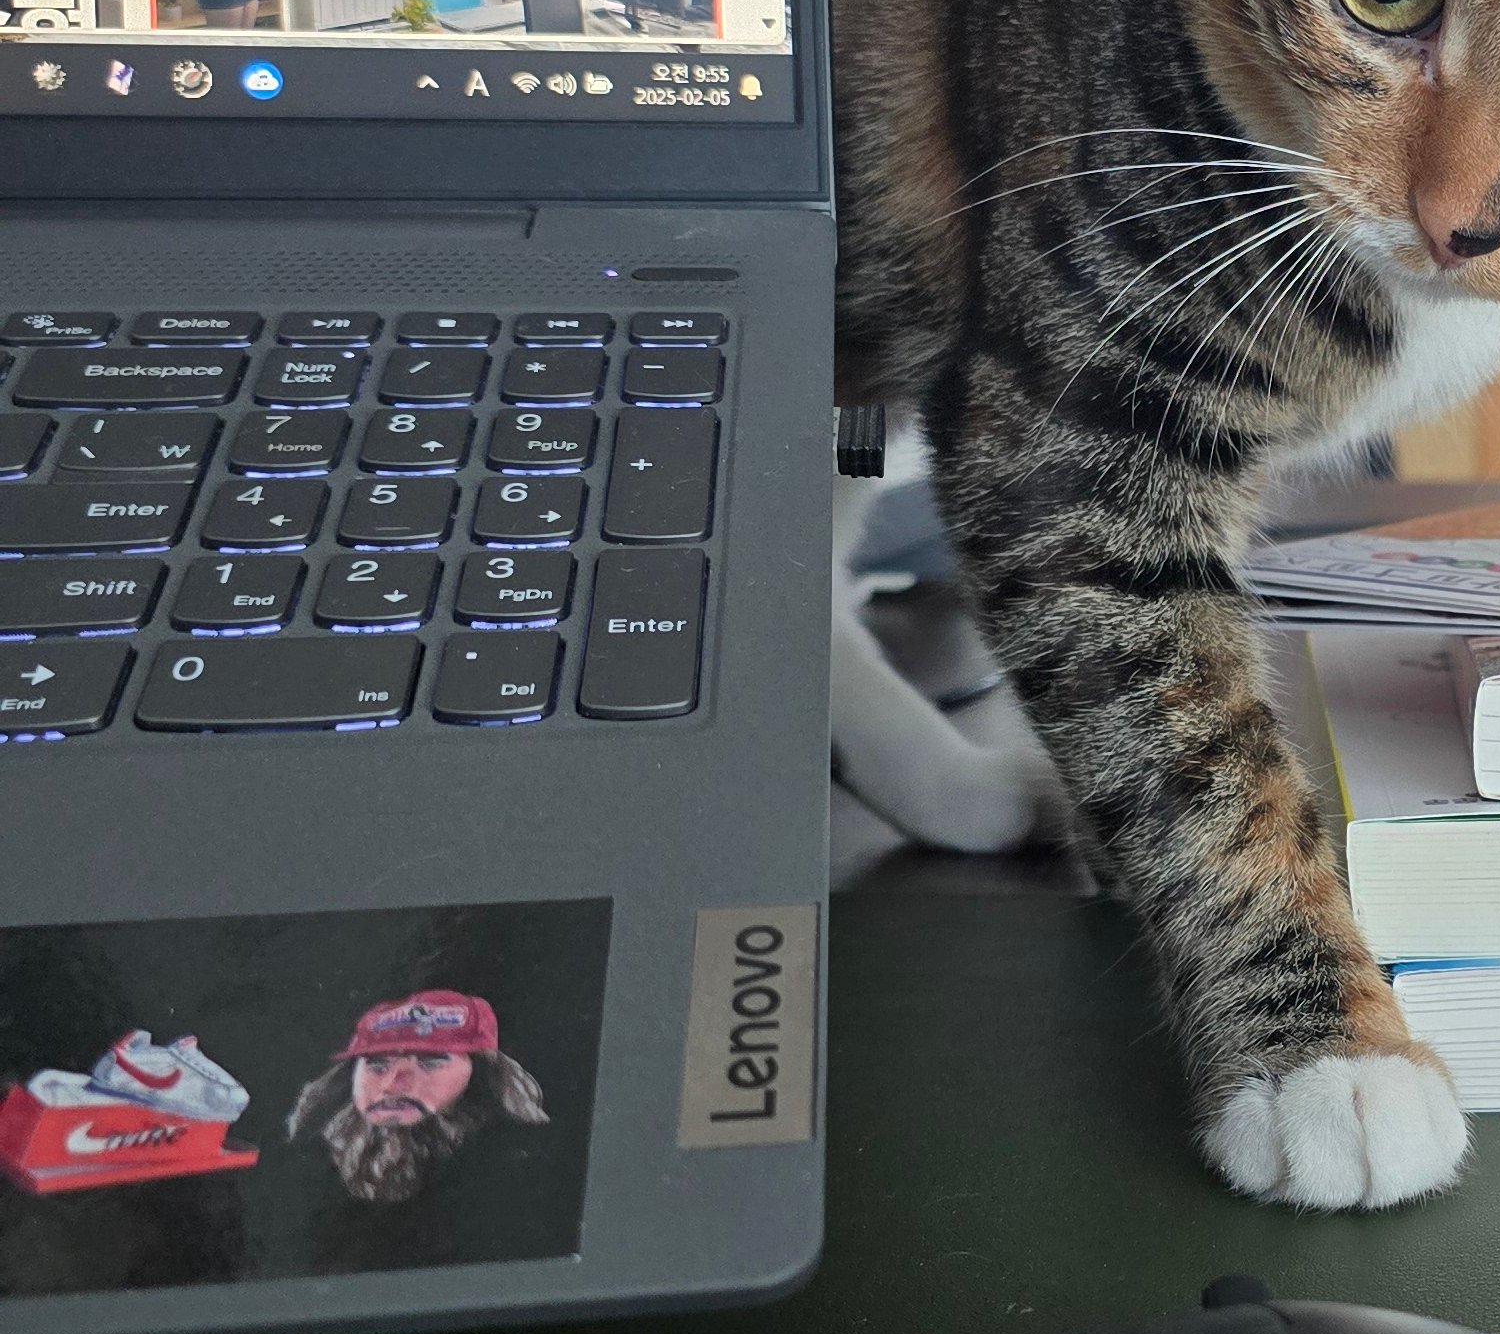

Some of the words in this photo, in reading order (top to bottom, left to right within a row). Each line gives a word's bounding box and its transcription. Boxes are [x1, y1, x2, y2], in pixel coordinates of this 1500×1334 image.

[651, 63, 690, 83] 오전
[692, 65, 730, 83] 9:55
[634, 87, 731, 105] 2025-02-05
[159, 318, 231, 330] Delete
[84, 364, 224, 378] Backspace
[285, 362, 337, 373] Num
[281, 372, 333, 384] Lock
[265, 415, 292, 434] 7
[387, 414, 417, 432] 8
[515, 413, 542, 432] 9
[268, 442, 323, 452] Home
[528, 440, 578, 452] PgUp
[236, 486, 265, 505] 4
[369, 484, 398, 505] 5
[500, 483, 529, 503] 6
[87, 503, 169, 517] Enter
[216, 563, 235, 584] 1
[346, 560, 379, 582] 2
[485, 557, 515, 579] 3
[63, 580, 137, 597] Shift
[499, 588, 553, 602] PgDn
[233, 594, 275, 607] End
[608, 619, 688, 634] Enter
[172, 656, 205, 682] 0
[358, 689, 389, 702] Ins
[500, 683, 536, 696] Del
[0, 698, 46, 711] End
[710, 925, 785, 1124] Lenovo
